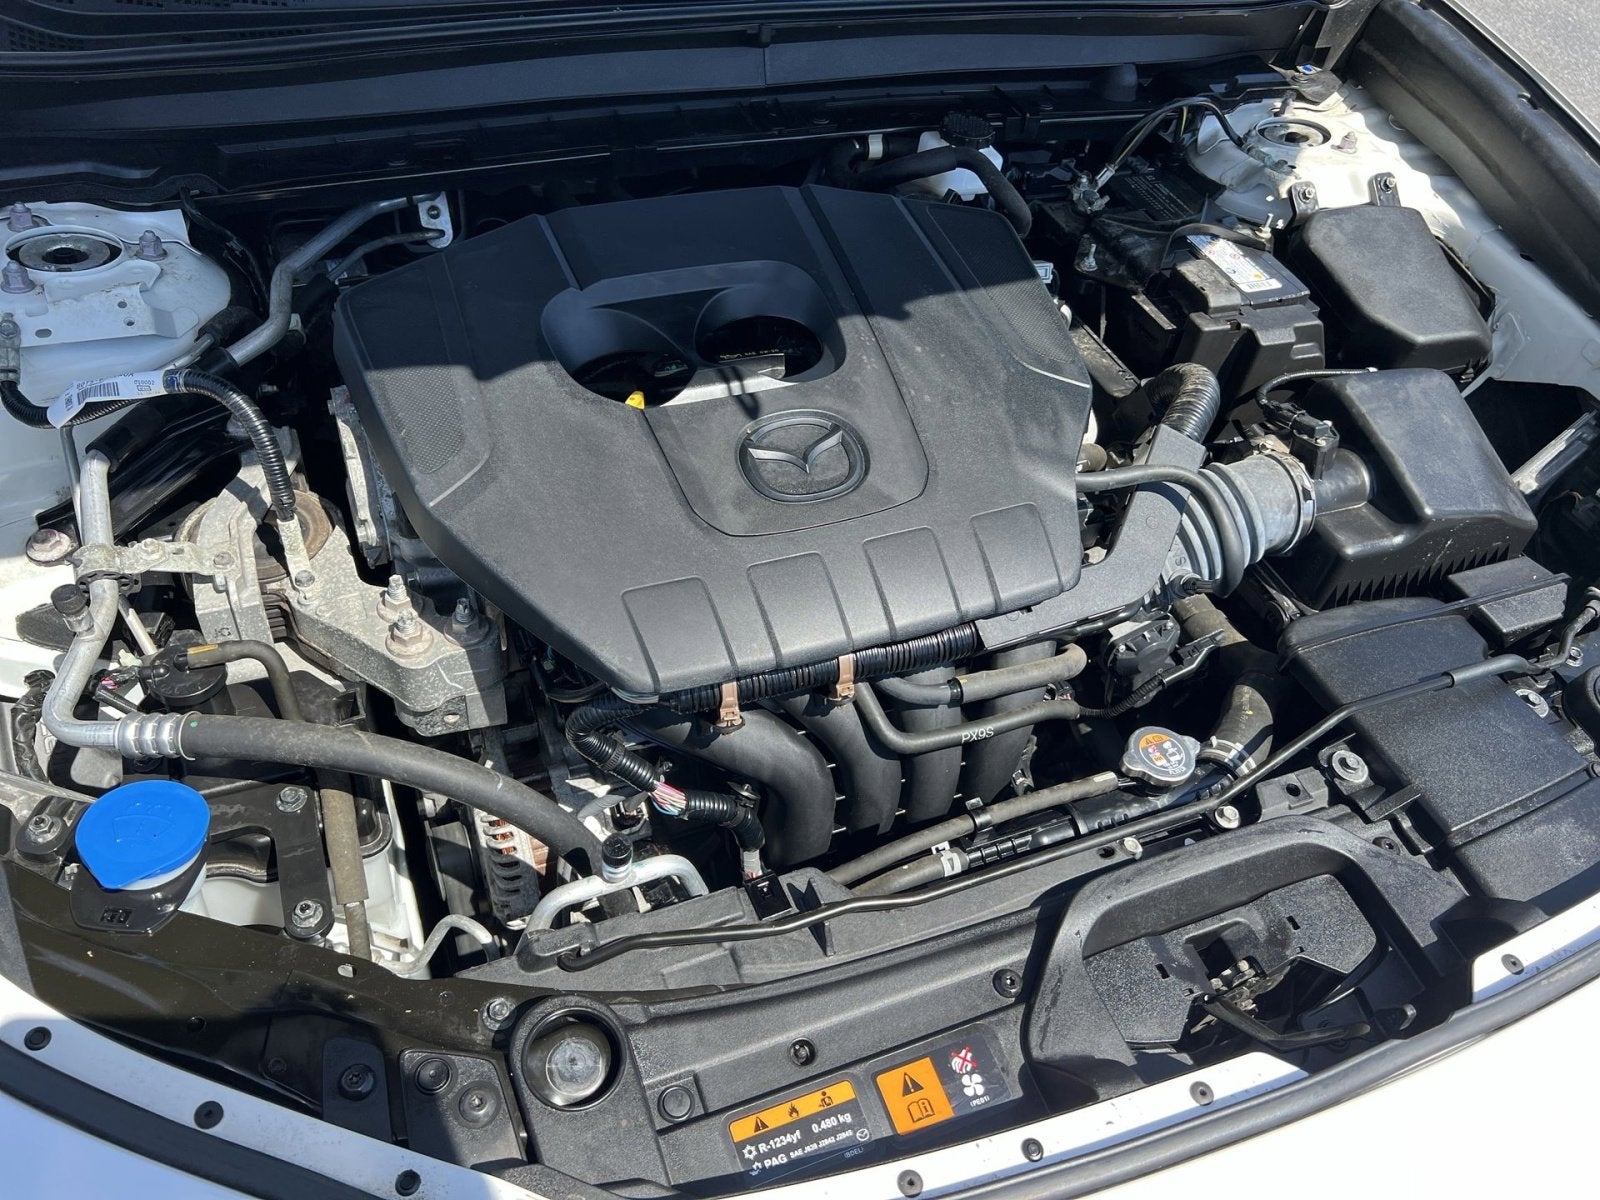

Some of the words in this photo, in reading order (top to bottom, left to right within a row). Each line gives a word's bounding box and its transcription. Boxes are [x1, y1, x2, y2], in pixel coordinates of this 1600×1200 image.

[961, 726, 994, 744] PX9S
[757, 1129, 802, 1154] R-1234yf
[811, 1115, 838, 1133] 0.480
[837, 1112, 852, 1124] kg
[763, 1153, 788, 1169] PAG
[789, 1148, 804, 1158] SAE
